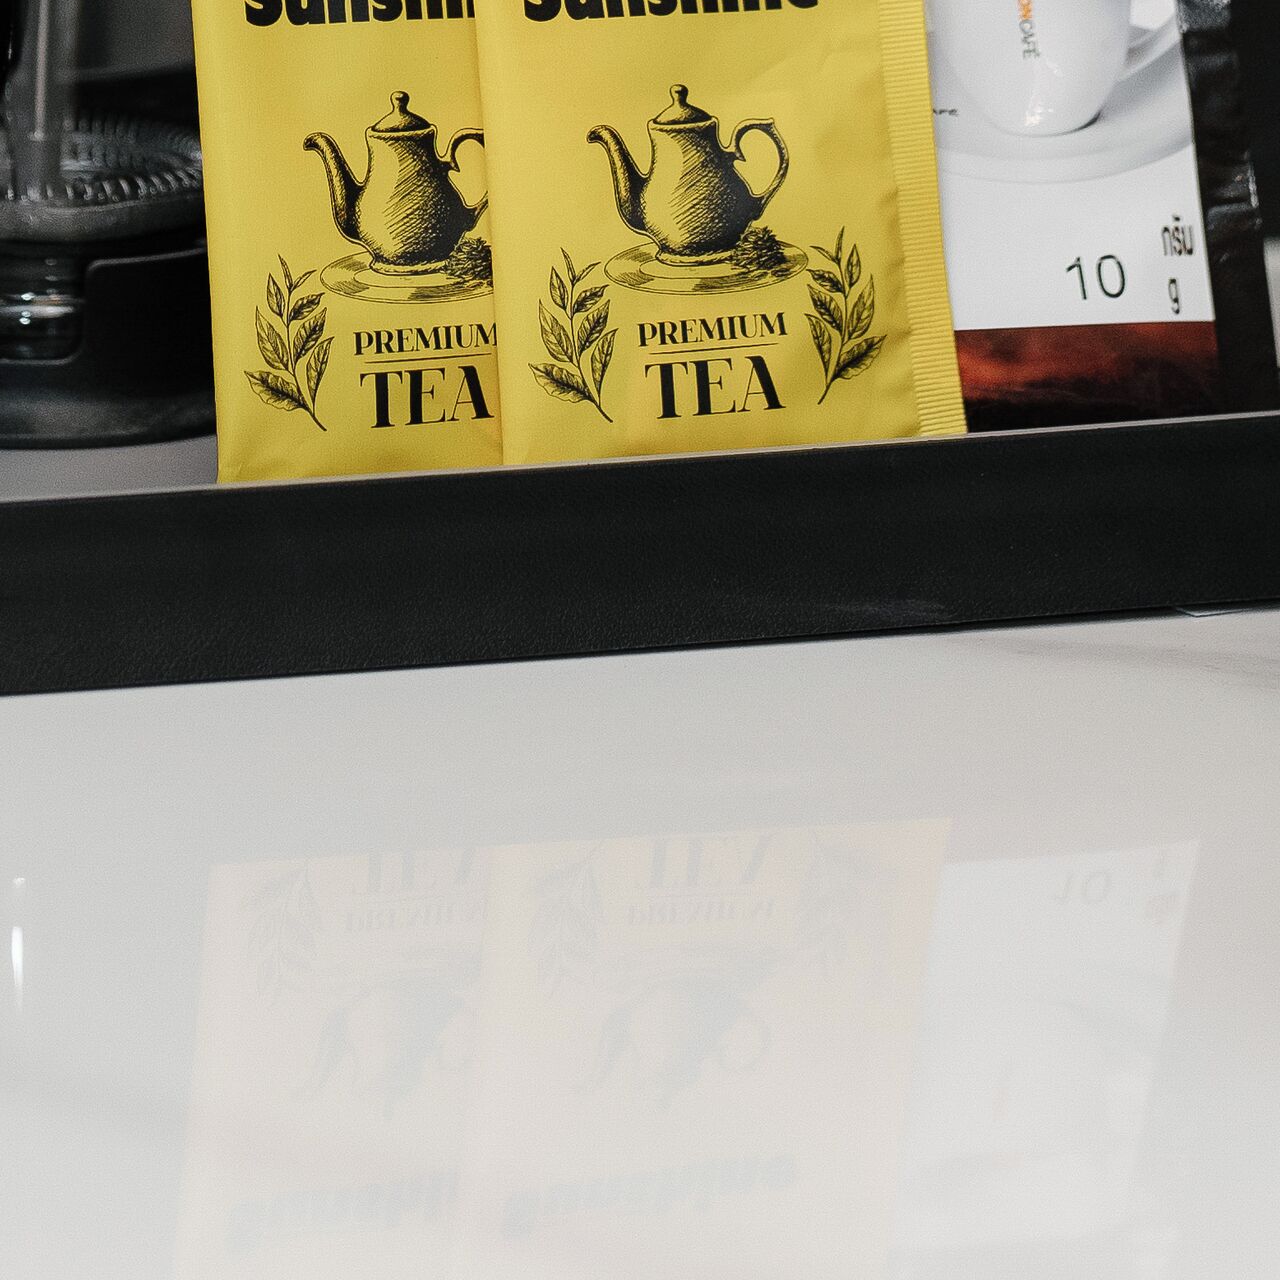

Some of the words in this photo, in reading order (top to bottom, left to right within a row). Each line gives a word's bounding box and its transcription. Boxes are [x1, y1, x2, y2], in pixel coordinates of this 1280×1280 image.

[1065, 254, 1125, 300] 10
[1168, 278, 1180, 315] g
[353, 322, 497, 355] PREMIUM
[637, 312, 788, 347] PREMIUM
[359, 365, 495, 428] TEA
[645, 355, 787, 419] TEA
